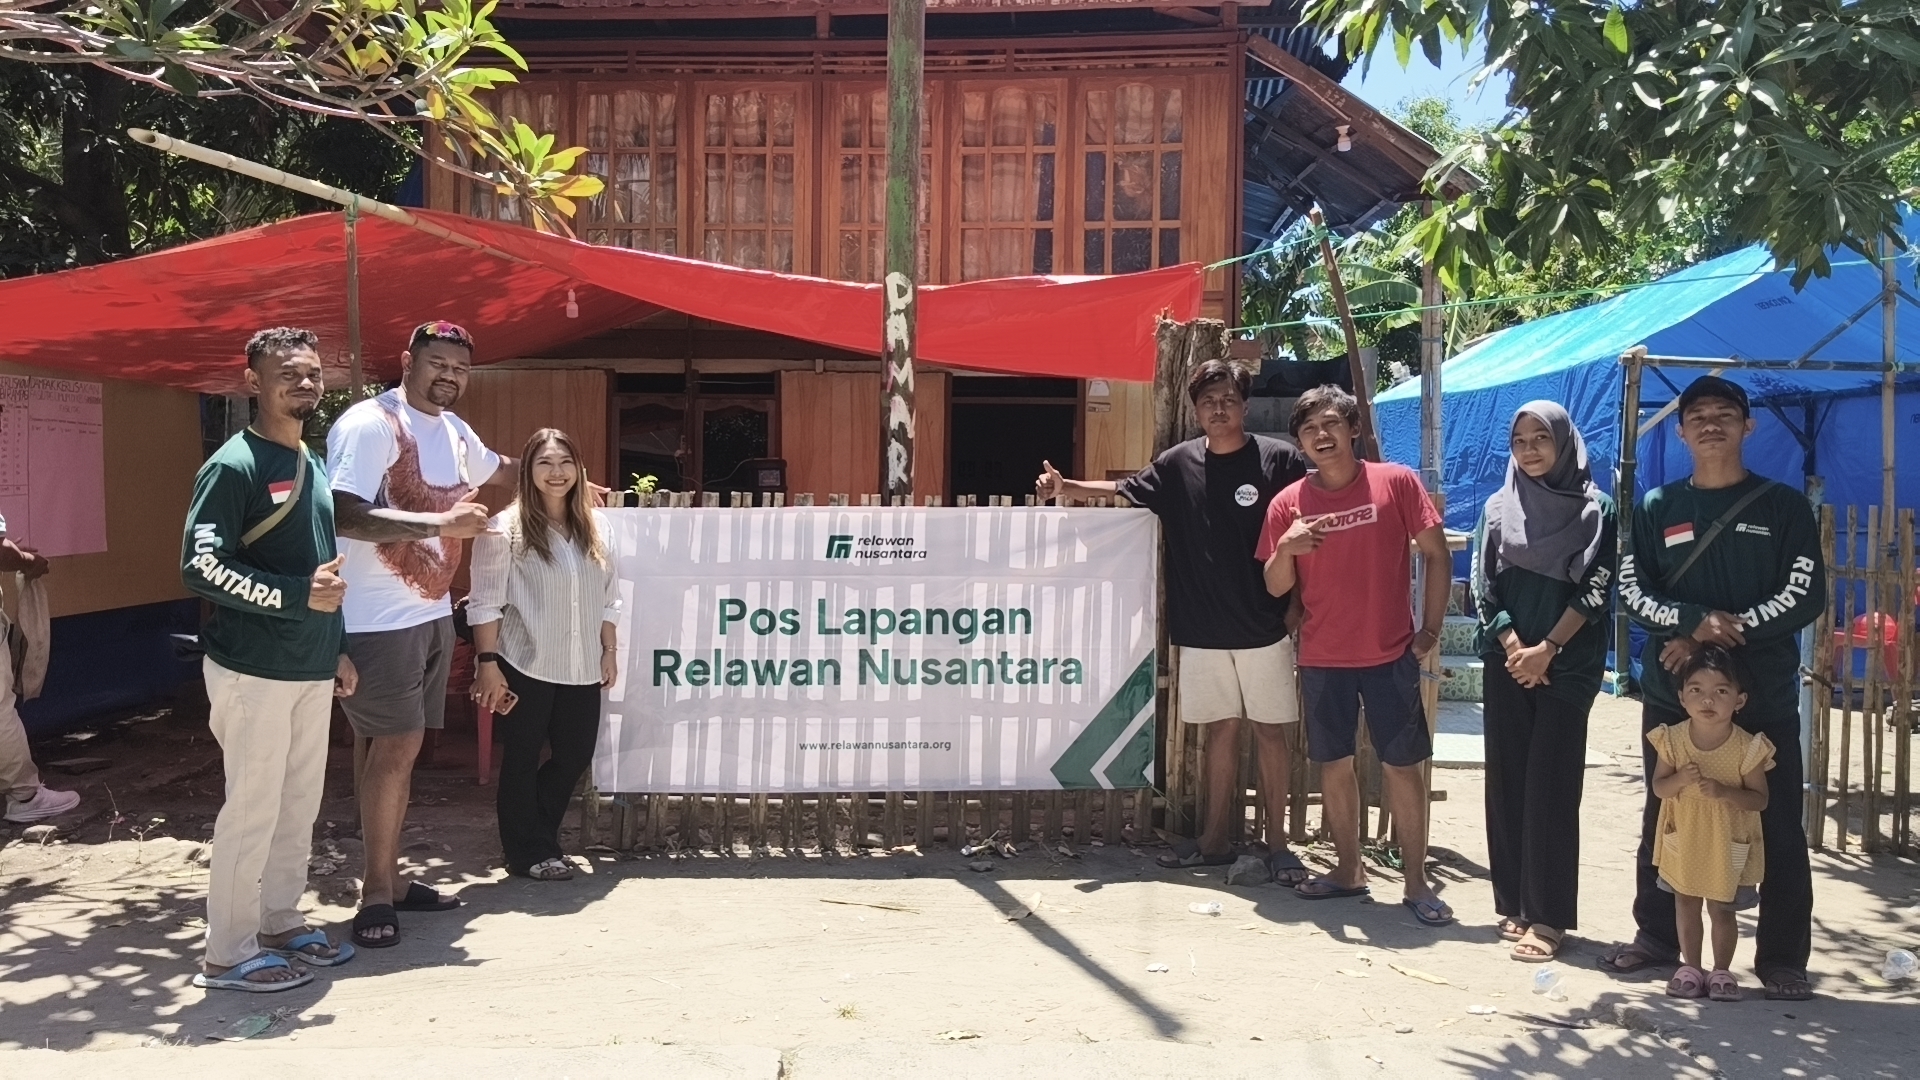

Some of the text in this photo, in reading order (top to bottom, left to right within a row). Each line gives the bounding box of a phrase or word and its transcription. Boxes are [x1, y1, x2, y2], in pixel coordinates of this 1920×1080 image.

[885, 271, 916, 490] DAMAR
[857, 535, 914, 546] relawan
[855, 549, 927, 559] nusantara
[719, 598, 1032, 645] Pos Lapangan
[653, 648, 1083, 687] Relawan Nusantara
[799, 738, 952, 752] www.relawannusantara.org
